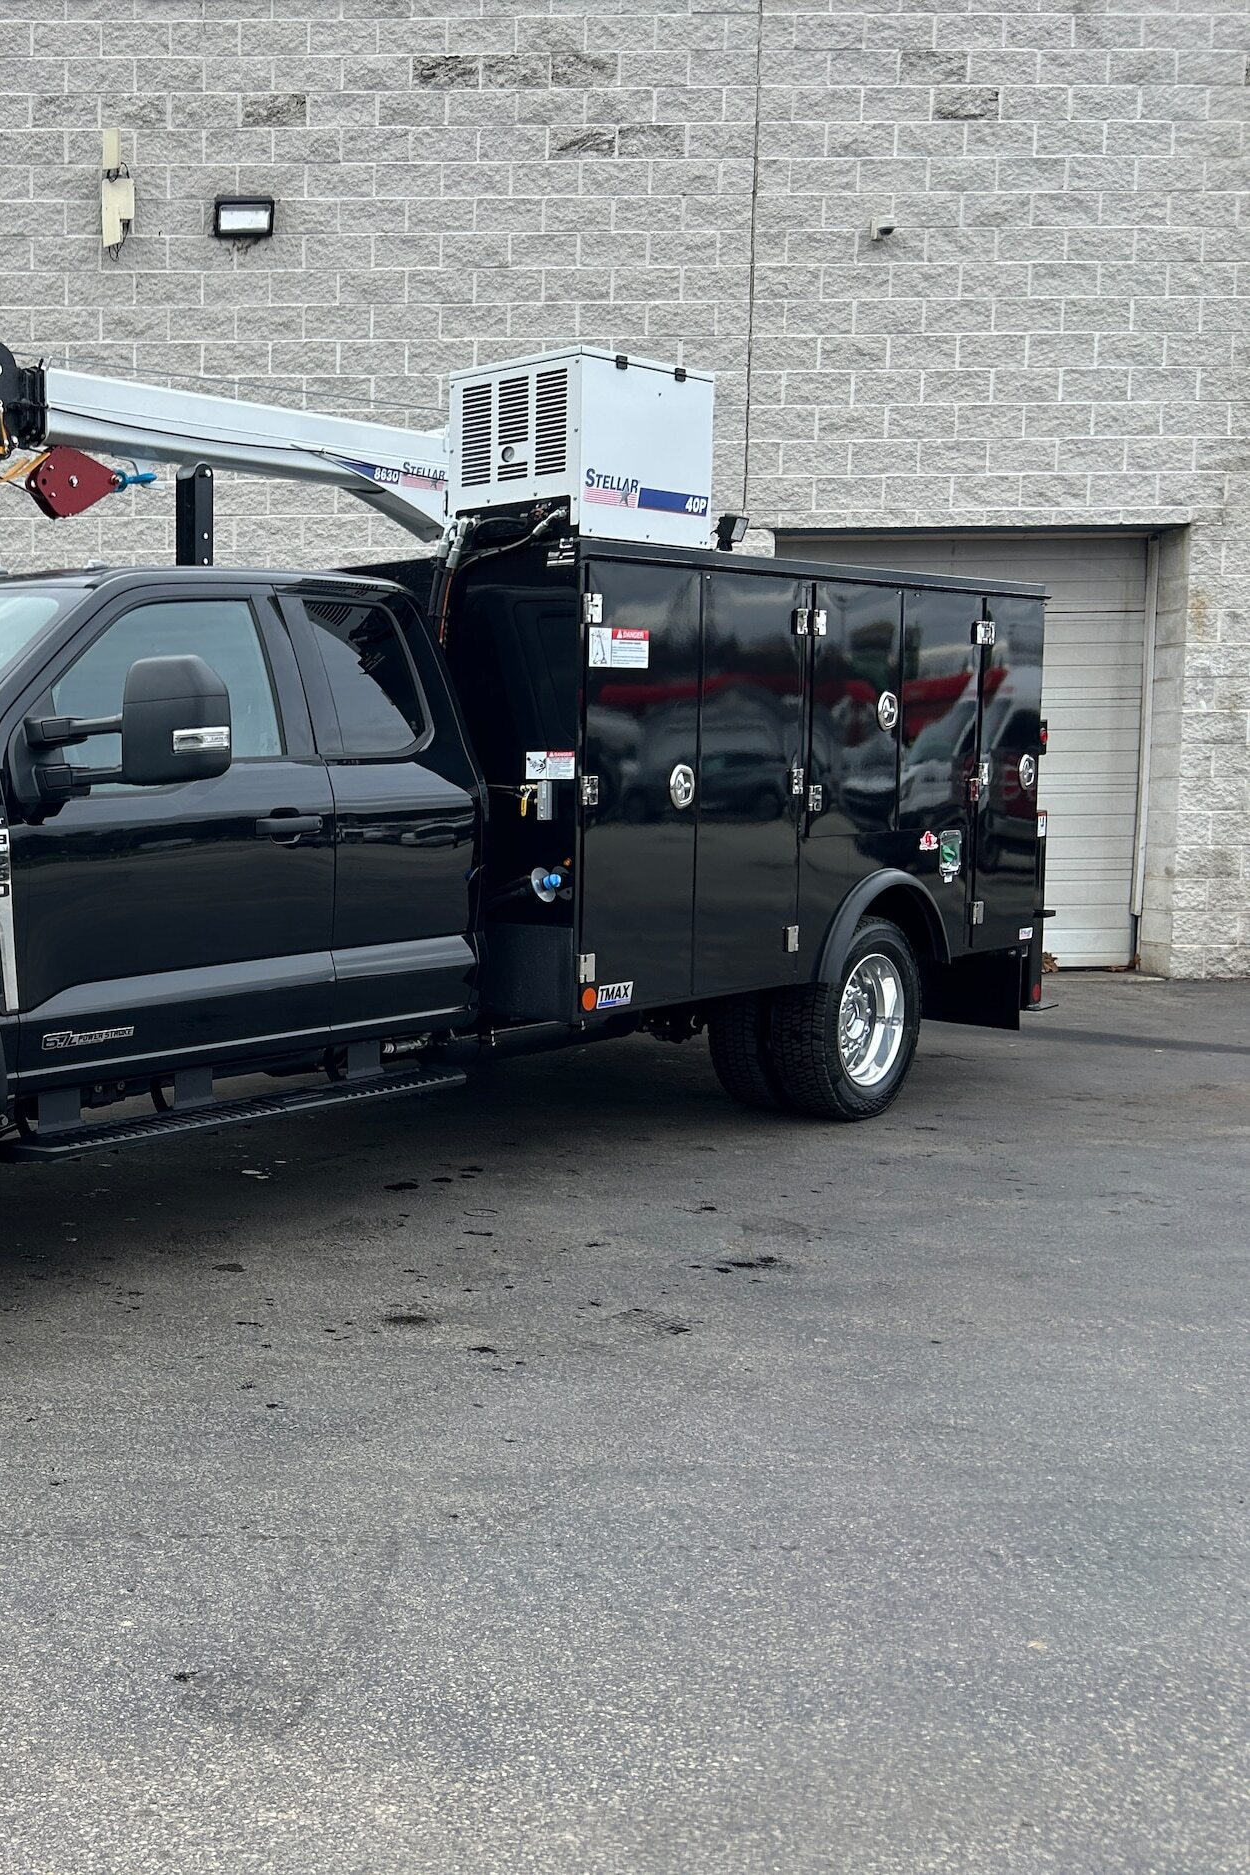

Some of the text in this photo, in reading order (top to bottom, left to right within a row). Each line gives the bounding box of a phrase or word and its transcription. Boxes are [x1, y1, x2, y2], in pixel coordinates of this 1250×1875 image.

[374, 467, 399, 482] 8630
[585, 468, 639, 494] STELLAR
[685, 496, 707, 513] 40P
[622, 630, 645, 639] DANGER
[599, 984, 630, 1002] TMAX
